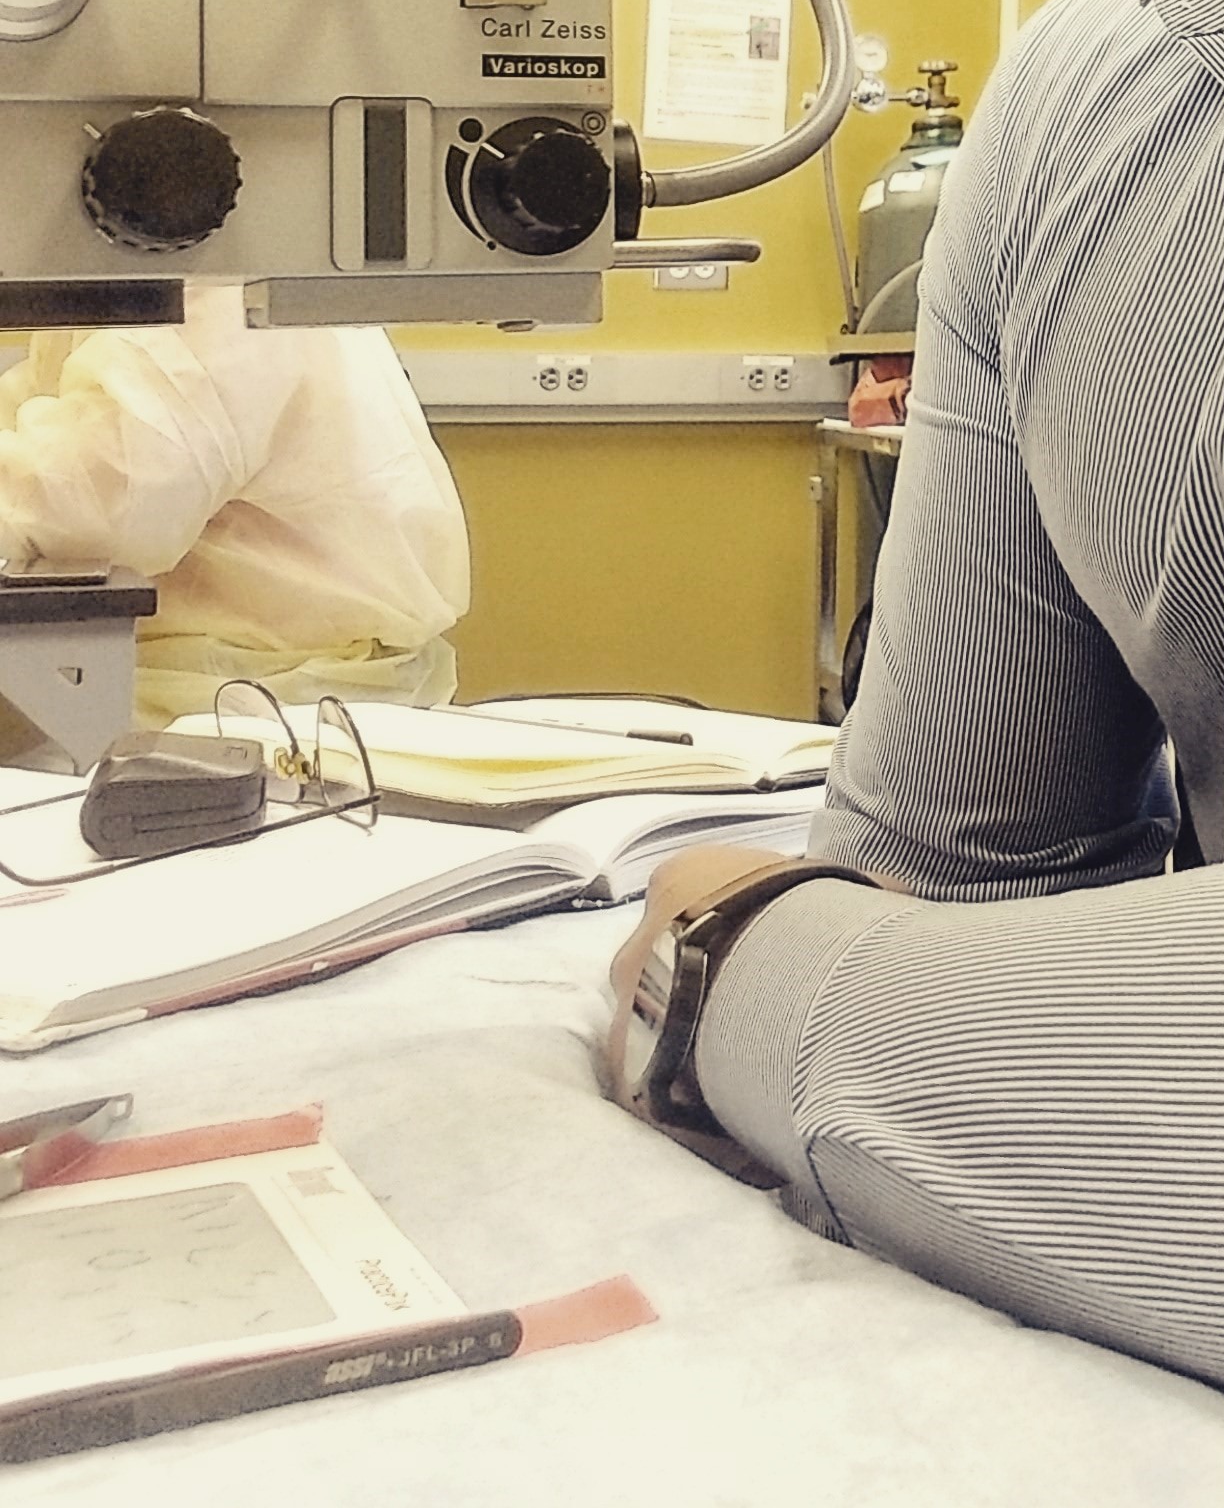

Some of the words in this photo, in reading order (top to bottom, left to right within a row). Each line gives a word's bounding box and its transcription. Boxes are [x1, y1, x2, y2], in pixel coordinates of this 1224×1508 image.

[481, 17, 531, 38] Carl
[541, 19, 606, 40] Zeiss
[489, 58, 600, 77] Varioskop
